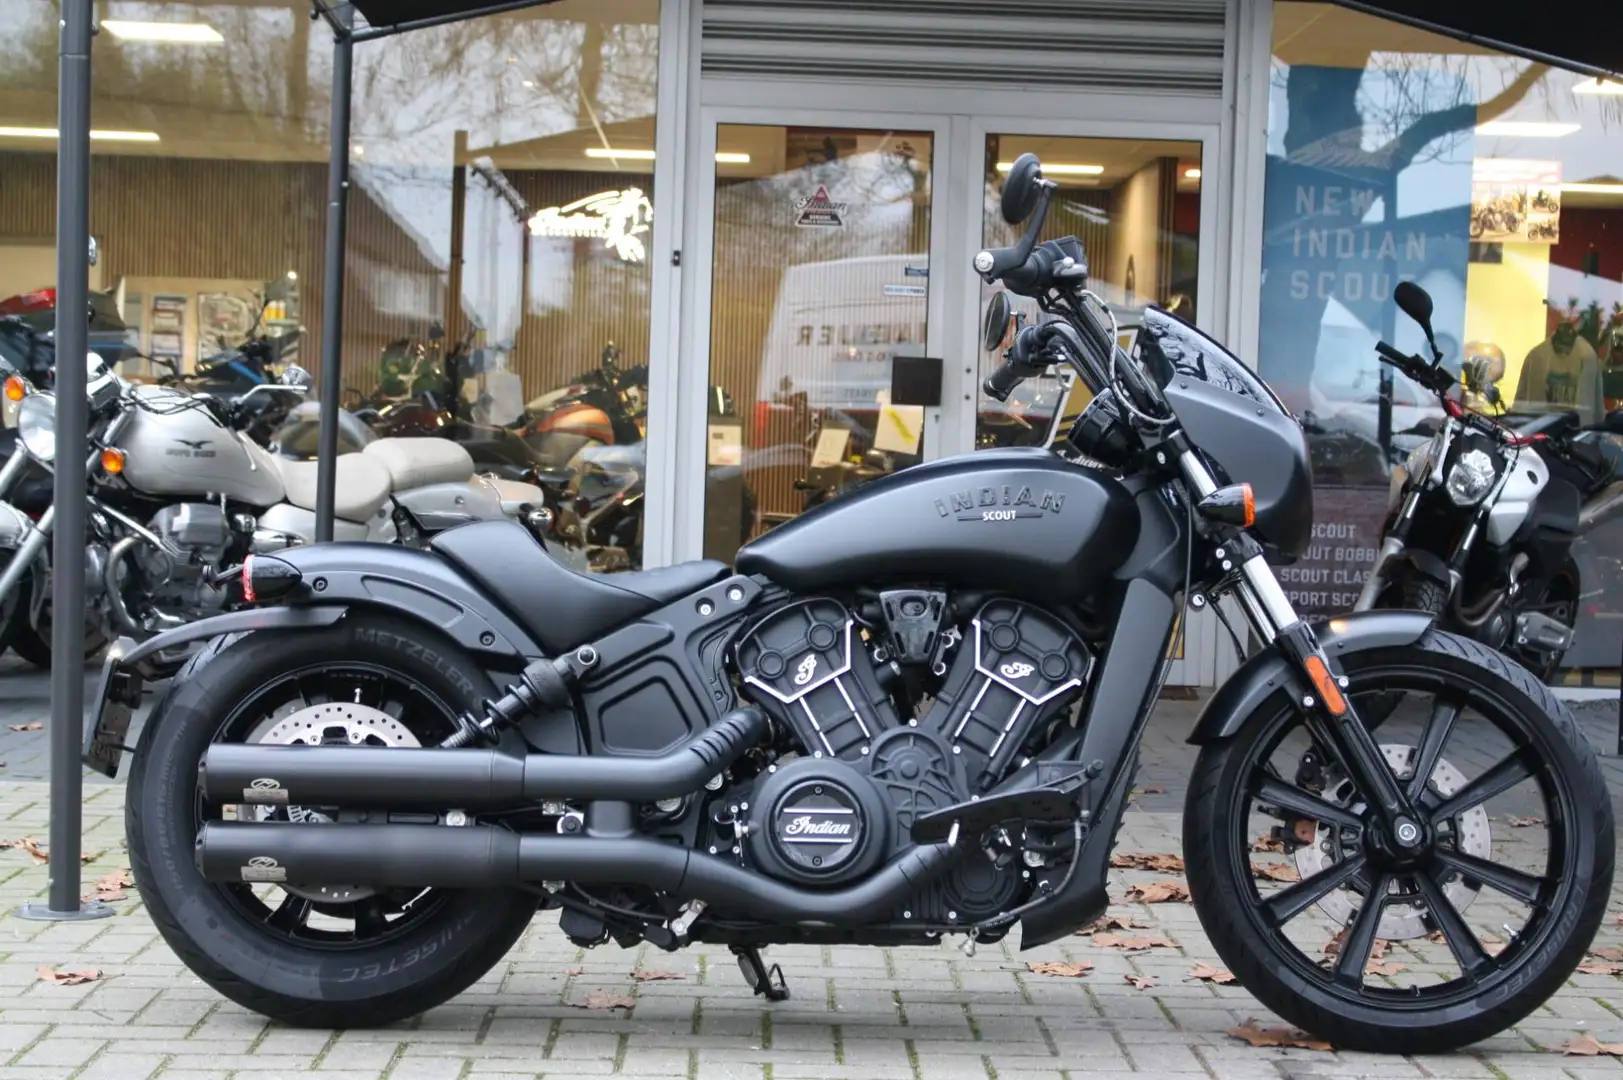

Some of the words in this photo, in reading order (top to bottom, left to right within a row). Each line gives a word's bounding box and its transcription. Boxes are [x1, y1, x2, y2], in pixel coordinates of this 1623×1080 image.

[1296, 185, 1376, 217] NEW
[1293, 228, 1426, 261] INDIAN
[1290, 269, 1416, 302] SCOU
[934, 485, 1066, 518] INDIAN
[982, 510, 1017, 521] SCOUT
[1335, 548, 1380, 562] BOBB
[1281, 568, 1331, 583] SCOUT
[1334, 570, 1372, 584] CLAS
[354, 627, 474, 696] METZELER
[785, 816, 851, 835] Indian
